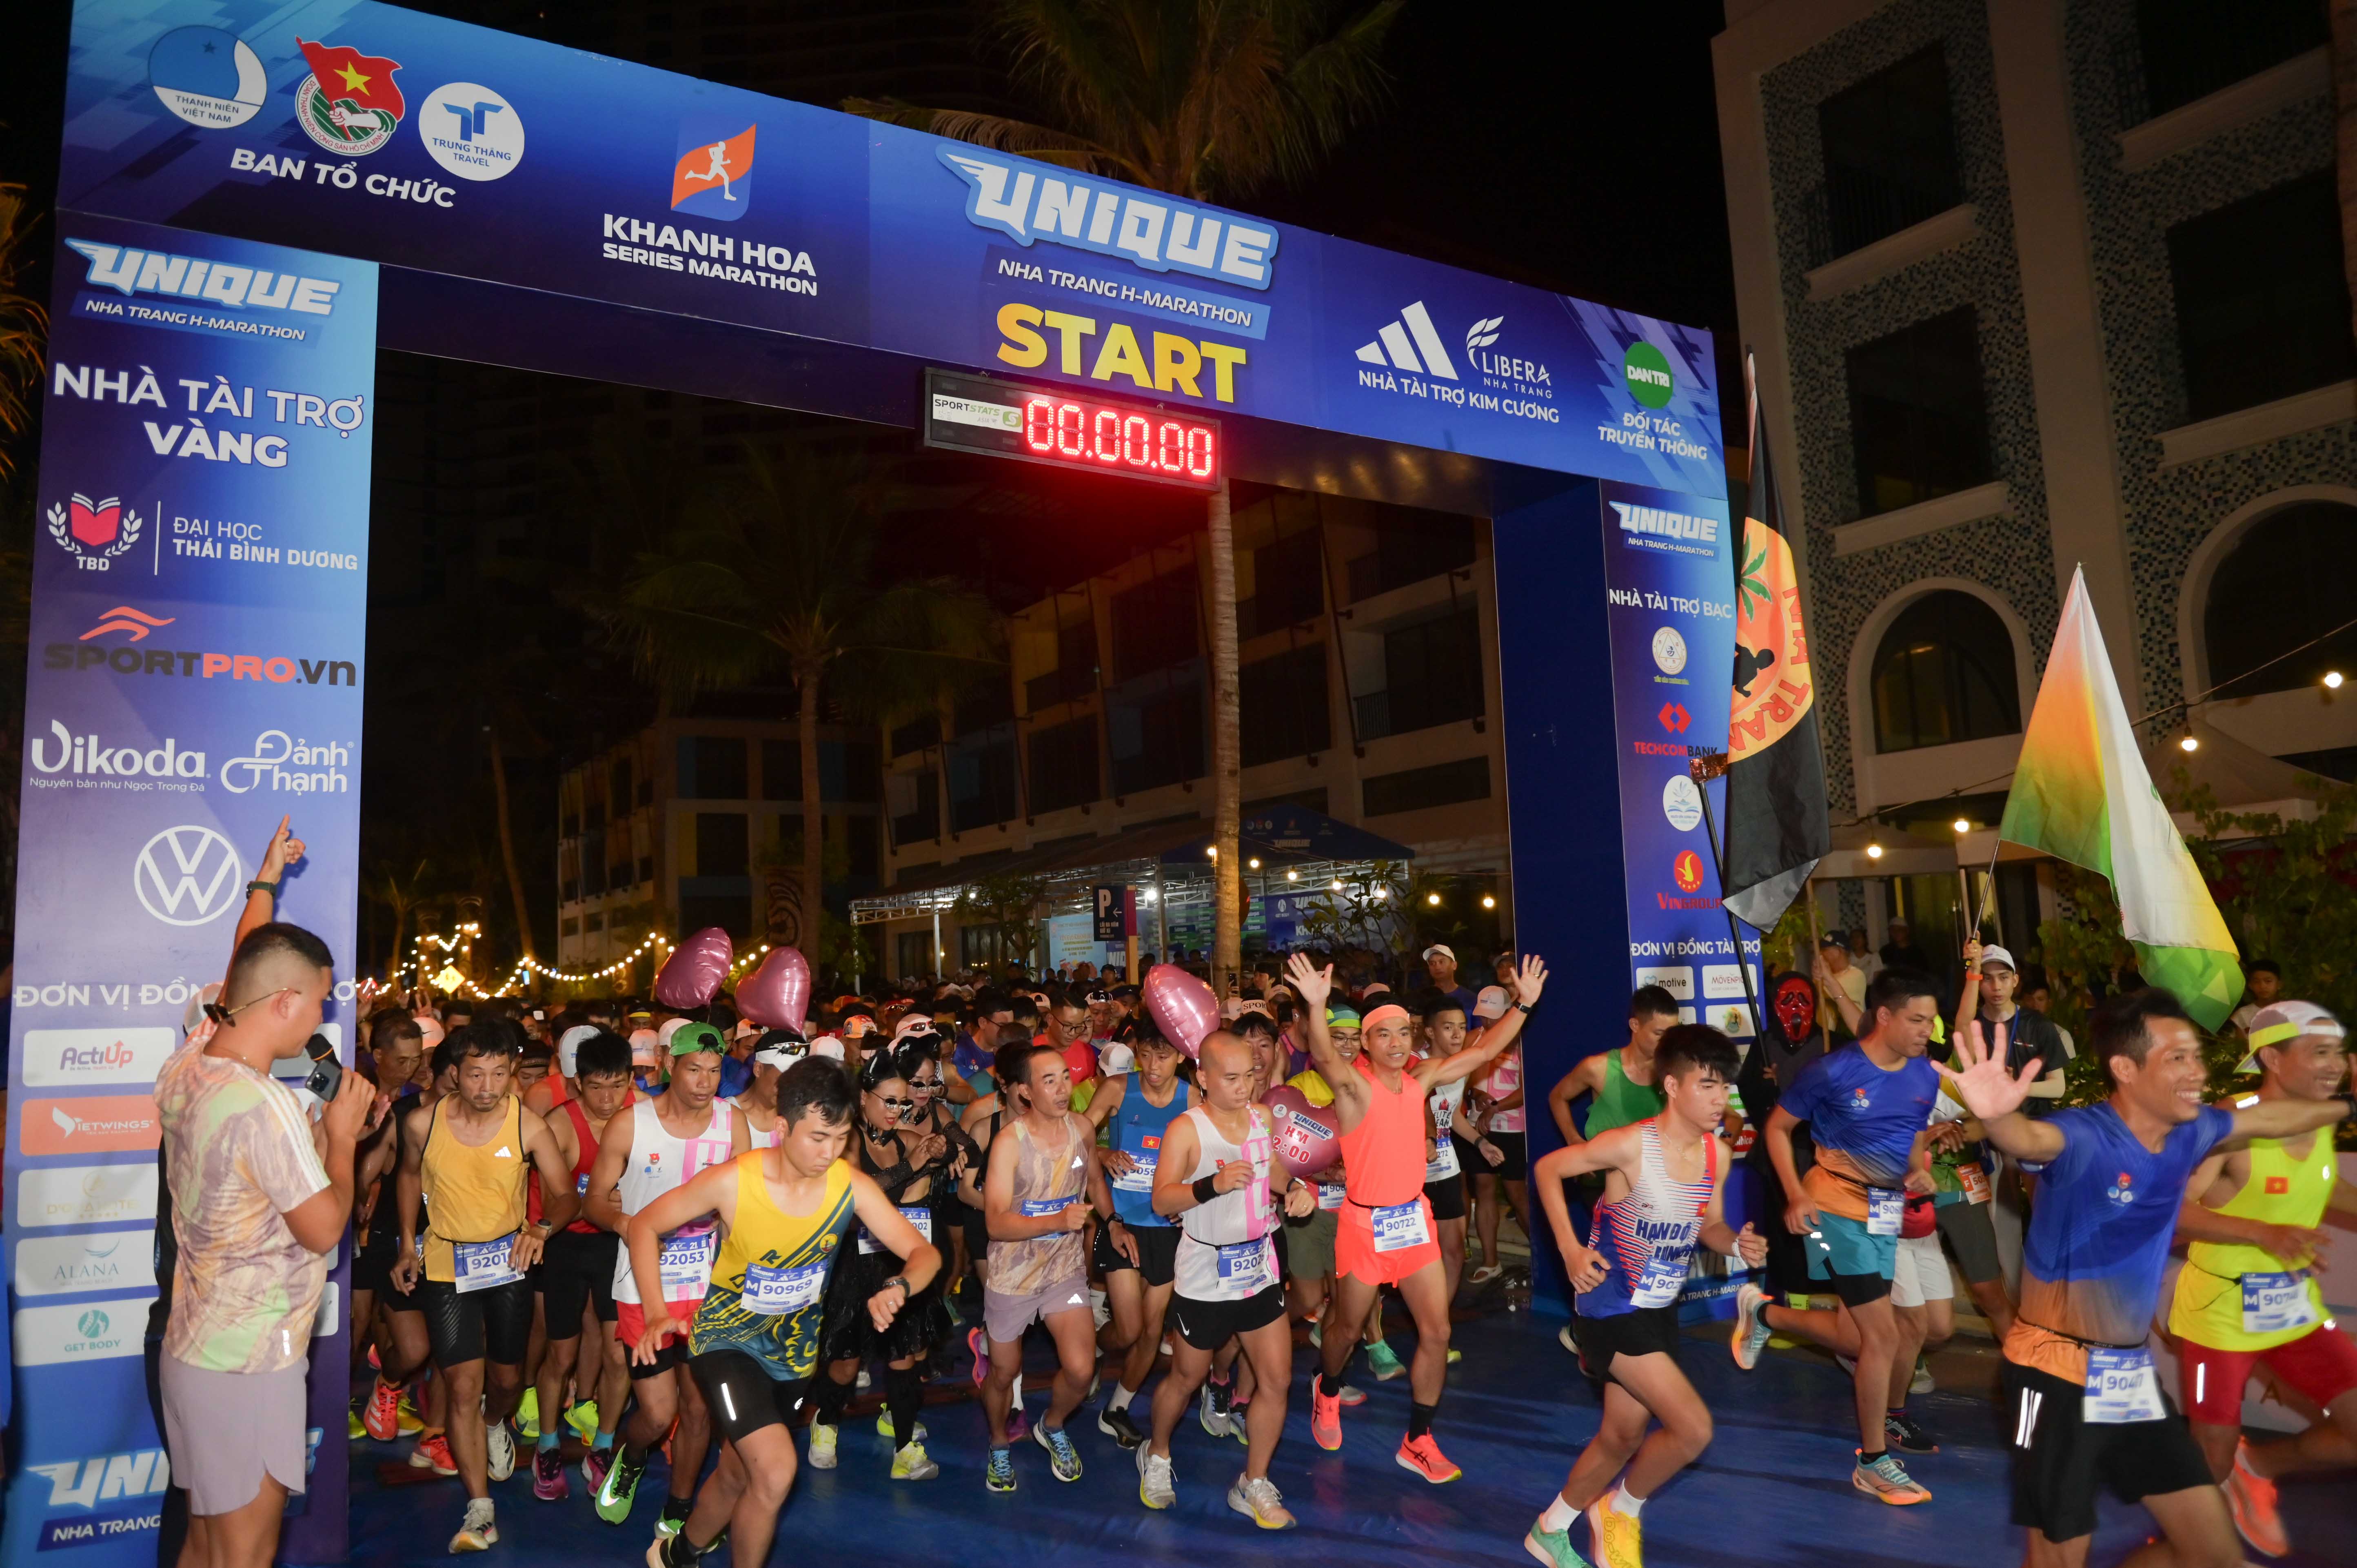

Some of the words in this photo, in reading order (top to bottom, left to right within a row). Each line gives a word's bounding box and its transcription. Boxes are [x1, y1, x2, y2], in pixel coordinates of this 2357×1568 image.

[176, 95, 211, 109] THANH
[215, 103, 239, 114] NIÊN
[182, 107, 205, 118] VIỆT
[208, 112, 231, 123] NAM
[370, 133, 385, 146] MINH
[432, 137, 471, 153] TRUNG
[453, 152, 490, 167] TRAVEL
[230, 148, 305, 181] BAN
[313, 160, 357, 189] TỔ
[365, 170, 456, 208] CHỨC
[945, 153, 1271, 282] UNIQUE
[604, 213, 733, 261] KHANH
[743, 240, 816, 277] HOA
[67, 240, 340, 315] UNIQUE
[603, 242, 684, 271] SERIES
[689, 259, 817, 296] MARATHON
[998, 258, 1043, 283] NHA
[1048, 269, 1118, 298] TRANG
[1121, 286, 1252, 327] H-MARATHON
[85, 299, 123, 316] NHA
[127, 306, 187, 325] TRANG
[189, 316, 306, 341] H-MARATHON
[996, 303, 1246, 403] START
[1482, 351, 1551, 386] LIBERA
[1359, 370, 1397, 392] NHÀ
[1400, 376, 1427, 398] TÀI
[1431, 383, 1466, 406] TRỢ
[1469, 392, 1499, 411] KIM
[1502, 399, 1560, 424] CƯƠNG
[1483, 377, 1509, 391] NHA
[1514, 381, 1552, 399] TRANG
[53, 362, 167, 408] NHÀ
[178, 375, 254, 419] TÀI
[266, 389, 364, 439] TRỢ
[934, 399, 1001, 416] SPORTSTATS
[1622, 410, 1650, 431] ĐỐI
[1653, 415, 1681, 437] TÁC
[143, 418, 289, 468] VÀNG
[1026, 399, 1212, 476] 00.00.00
[1598, 424, 1655, 452] TRUYỀN
[1658, 437, 1708, 461] THÔNG
[173, 516, 209, 537] ĐẠI
[218, 521, 263, 542] HỌC
[1609, 501, 1718, 542] UNIQUE
[173, 536, 222, 559] THÁI
[229, 541, 280, 564] BÌNH
[287, 548, 358, 570] DƯƠNG
[1628, 537, 1643, 546] NHA
[1644, 539, 1668, 550] TRANG
[1669, 543, 1714, 557] H-MARATHON
[76, 556, 110, 571] TBD
[1609, 588, 1642, 608] NHÀ
[1645, 590, 1668, 611] TÀI
[1671, 597, 1700, 618] TRỢ
[1703, 601, 1733, 621] BẠC
[44, 643, 357, 687] SPORTPRO.vn
[1633, 741, 1718, 758] TECHCOMBANK
[29, 777, 73, 788] Nguyên
[77, 779, 98, 789] bản
[100, 780, 122, 789] như
[124, 781, 154, 791] Ngọc
[157, 781, 187, 792] Trong
[189, 782, 205, 792] Đá
[1099, 889, 1112, 918] P
[1657, 892, 1723, 910] VINGROUP
[1631, 940, 1660, 956] ĐƠN
[1662, 942, 1676, 958] VỊ
[1677, 937, 1713, 955] ĐỒNG
[1715, 938, 1734, 954] TÀI
[1741, 938, 1761, 956] RỢ
[1658, 977, 1687, 988] motive
[13, 981, 91, 1008] ĐƠN
[99, 983, 130, 1011] VỊ
[1294, 1112, 1332, 1137] UNIQUE
[1273, 1136, 1311, 1164] 2:00
[1869, 1204, 1880, 1213] M
[1374, 1224, 1383, 1233] M
[1386, 1217, 1417, 1231] 90722
[499, 1242, 509, 1251] 21
[471, 1251, 510, 1270] 9201
[659, 1251, 704, 1266] 92053
[1234, 1253, 1265, 1272] 92026
[54, 1262, 119, 1280] ALANA
[1640, 1275, 1653, 1286] M
[746, 1280, 759, 1291] M
[763, 1278, 813, 1295] 90969
[1687, 1289, 1711, 1300] TRANG
[2244, 1294, 2258, 1305] M
[64, 1342, 86, 1353] GET
[89, 1339, 121, 1350] BODY
[2087, 1375, 2102, 1389] M
[53, 1524, 94, 1542] NHA
[98, 1515, 161, 1535] TRANG
